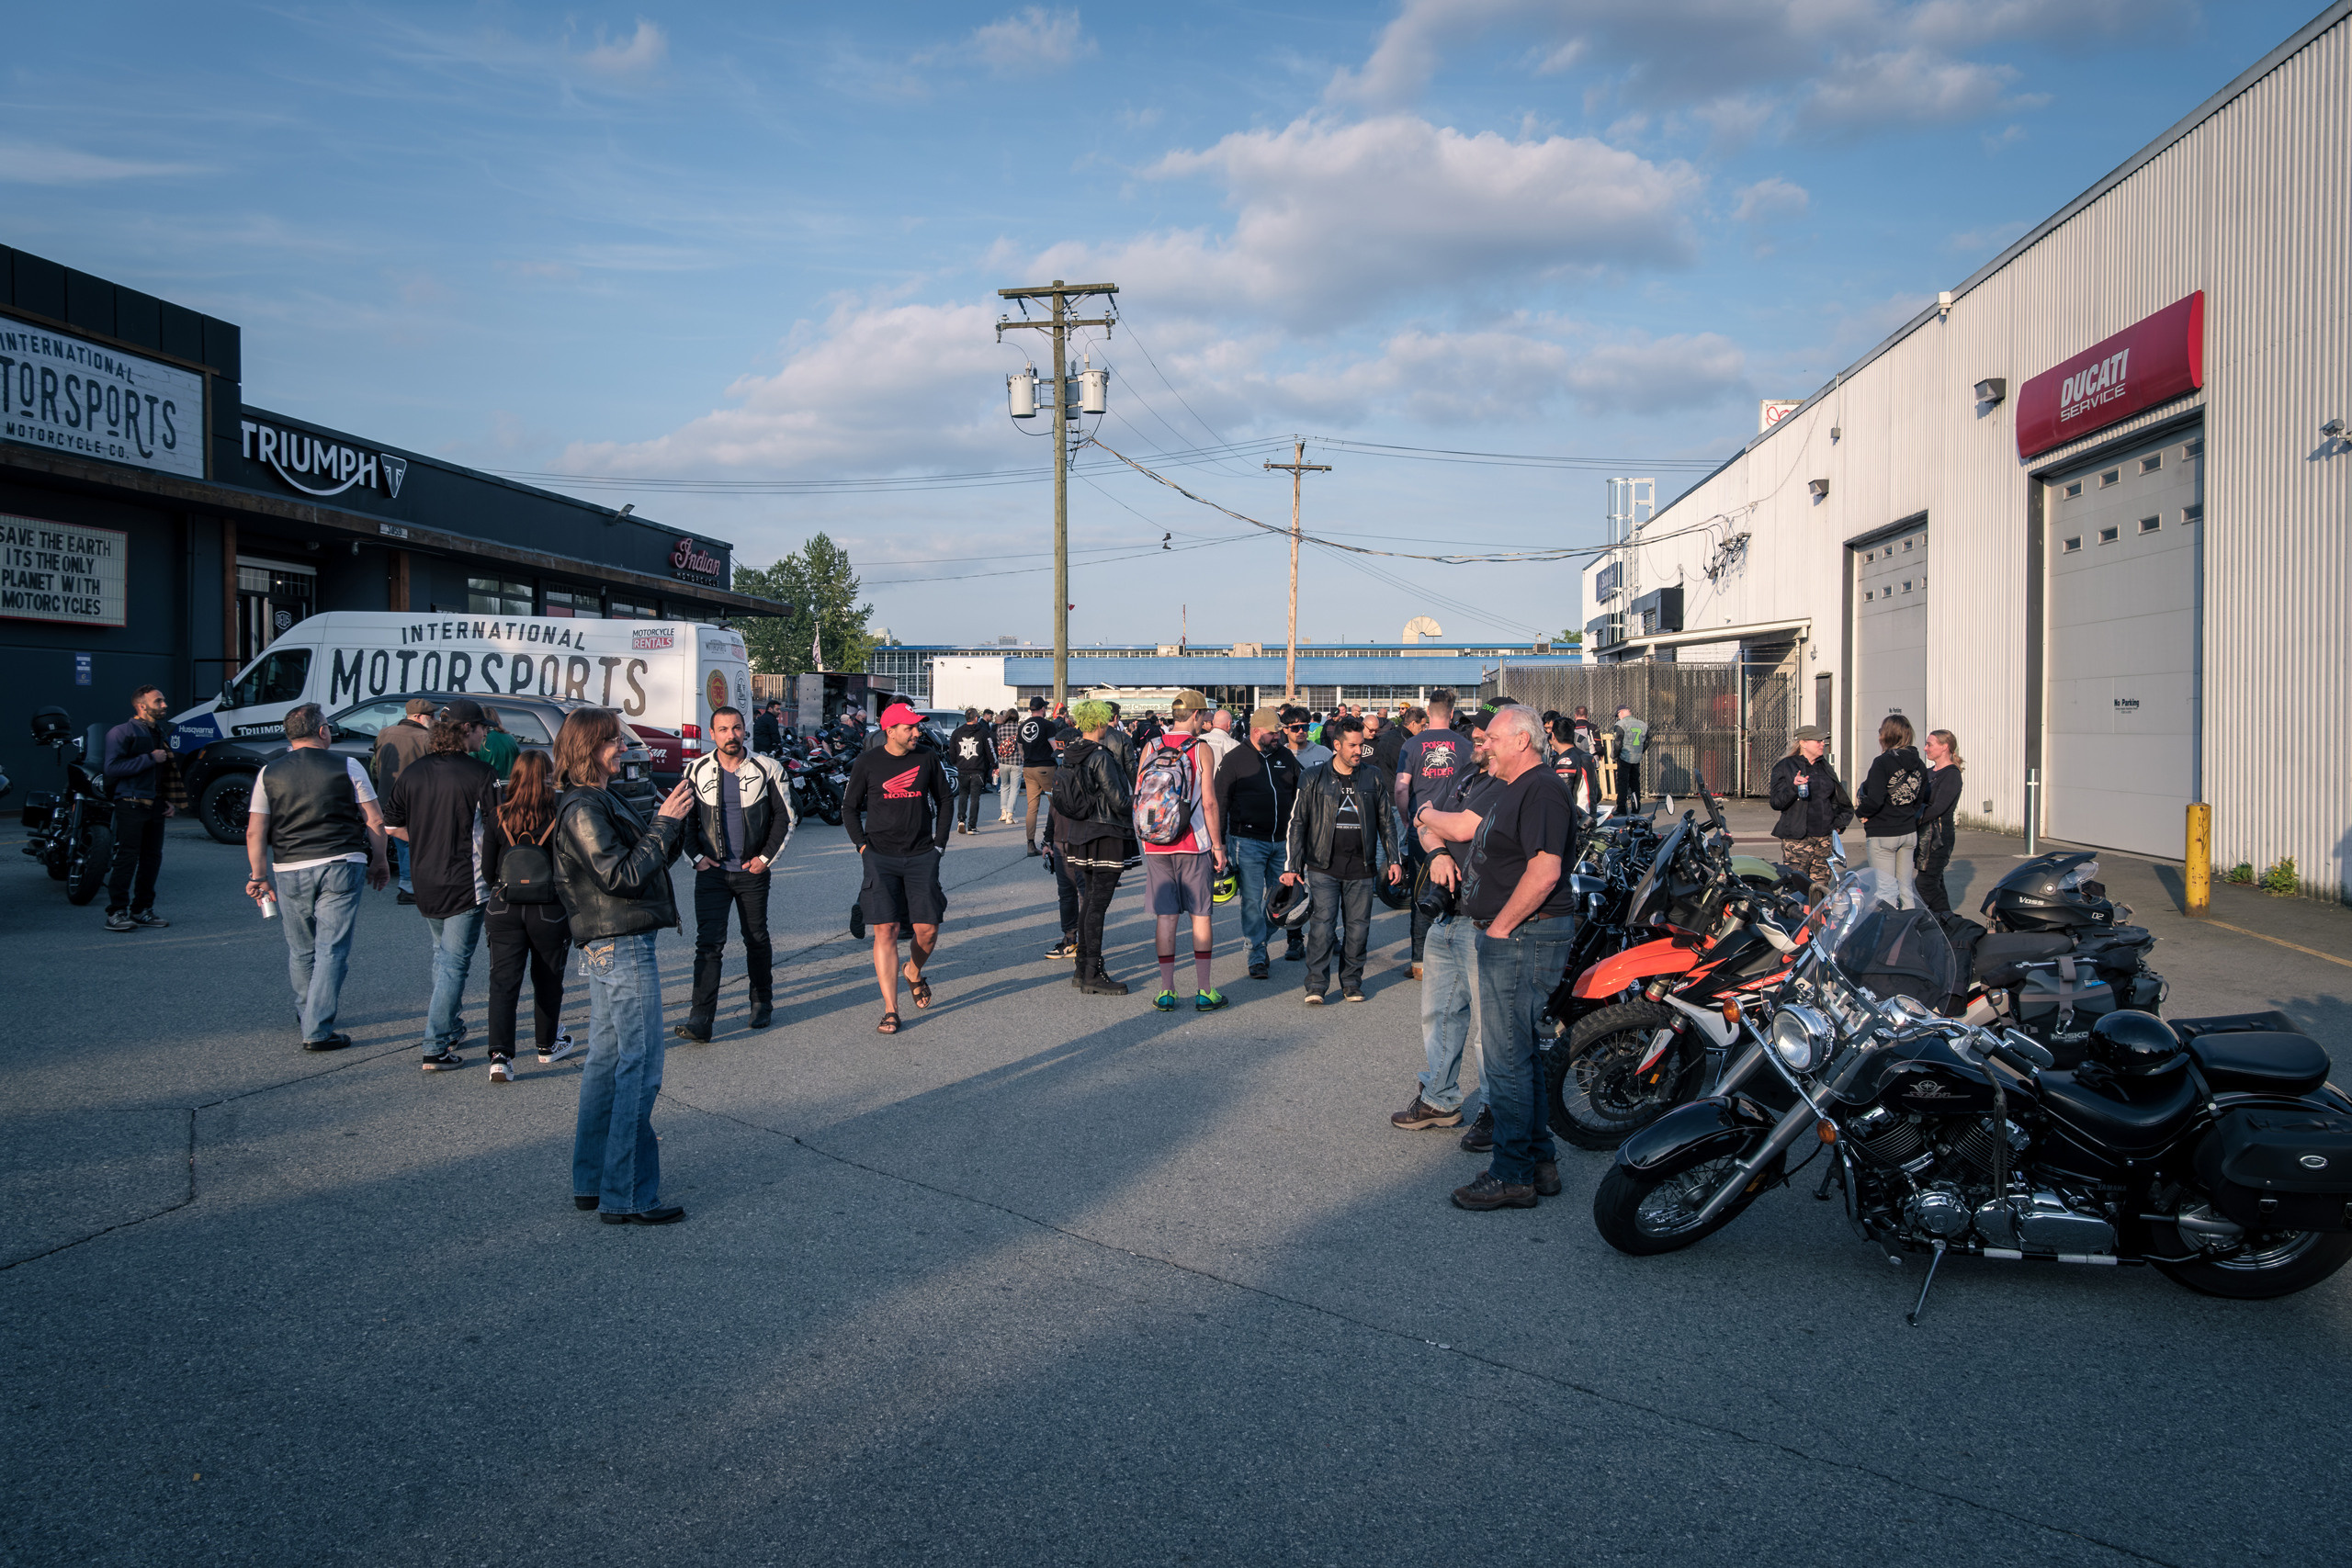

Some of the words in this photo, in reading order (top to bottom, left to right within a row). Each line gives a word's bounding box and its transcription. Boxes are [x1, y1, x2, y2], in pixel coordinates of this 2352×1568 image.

[0, 333, 134, 385] INTERNATIONAL
[2060, 347, 2130, 409] DUCATI
[0, 355, 177, 459] TORSPORTS
[2060, 383, 2126, 423] SERVICE
[6, 422, 101, 454] MOTORCYCLE
[109, 444, 130, 459] CO.
[241, 420, 378, 497] TRIUMPH
[0, 525, 35, 547] SAVE
[39, 531, 63, 551] THE
[67, 536, 111, 558] EARTH
[36, 552, 61, 571] THE
[62, 556, 95, 575] ONLY
[674, 537, 721, 577] Indian
[2, 569, 54, 591] PLANET
[61, 574, 100, 596] WITH
[1, 590, 101, 615] MOTORCYCLES
[401, 621, 585, 651] INTERNATIONAL
[632, 628, 675, 637] MOTORCYCLE
[632, 637, 673, 649] RENTALS
[330, 649, 649, 716] MOTORSPORTS
[178, 725, 214, 734] Husqvarna
[1630, 728, 1642, 746] 7
[1421, 740, 1456, 756] POISON
[1421, 766, 1454, 777] SPIDER
[883, 790, 922, 799] HONDA
[2018, 896, 2045, 906] Voss
[2098, 1182, 2128, 1191] YAMAHA
